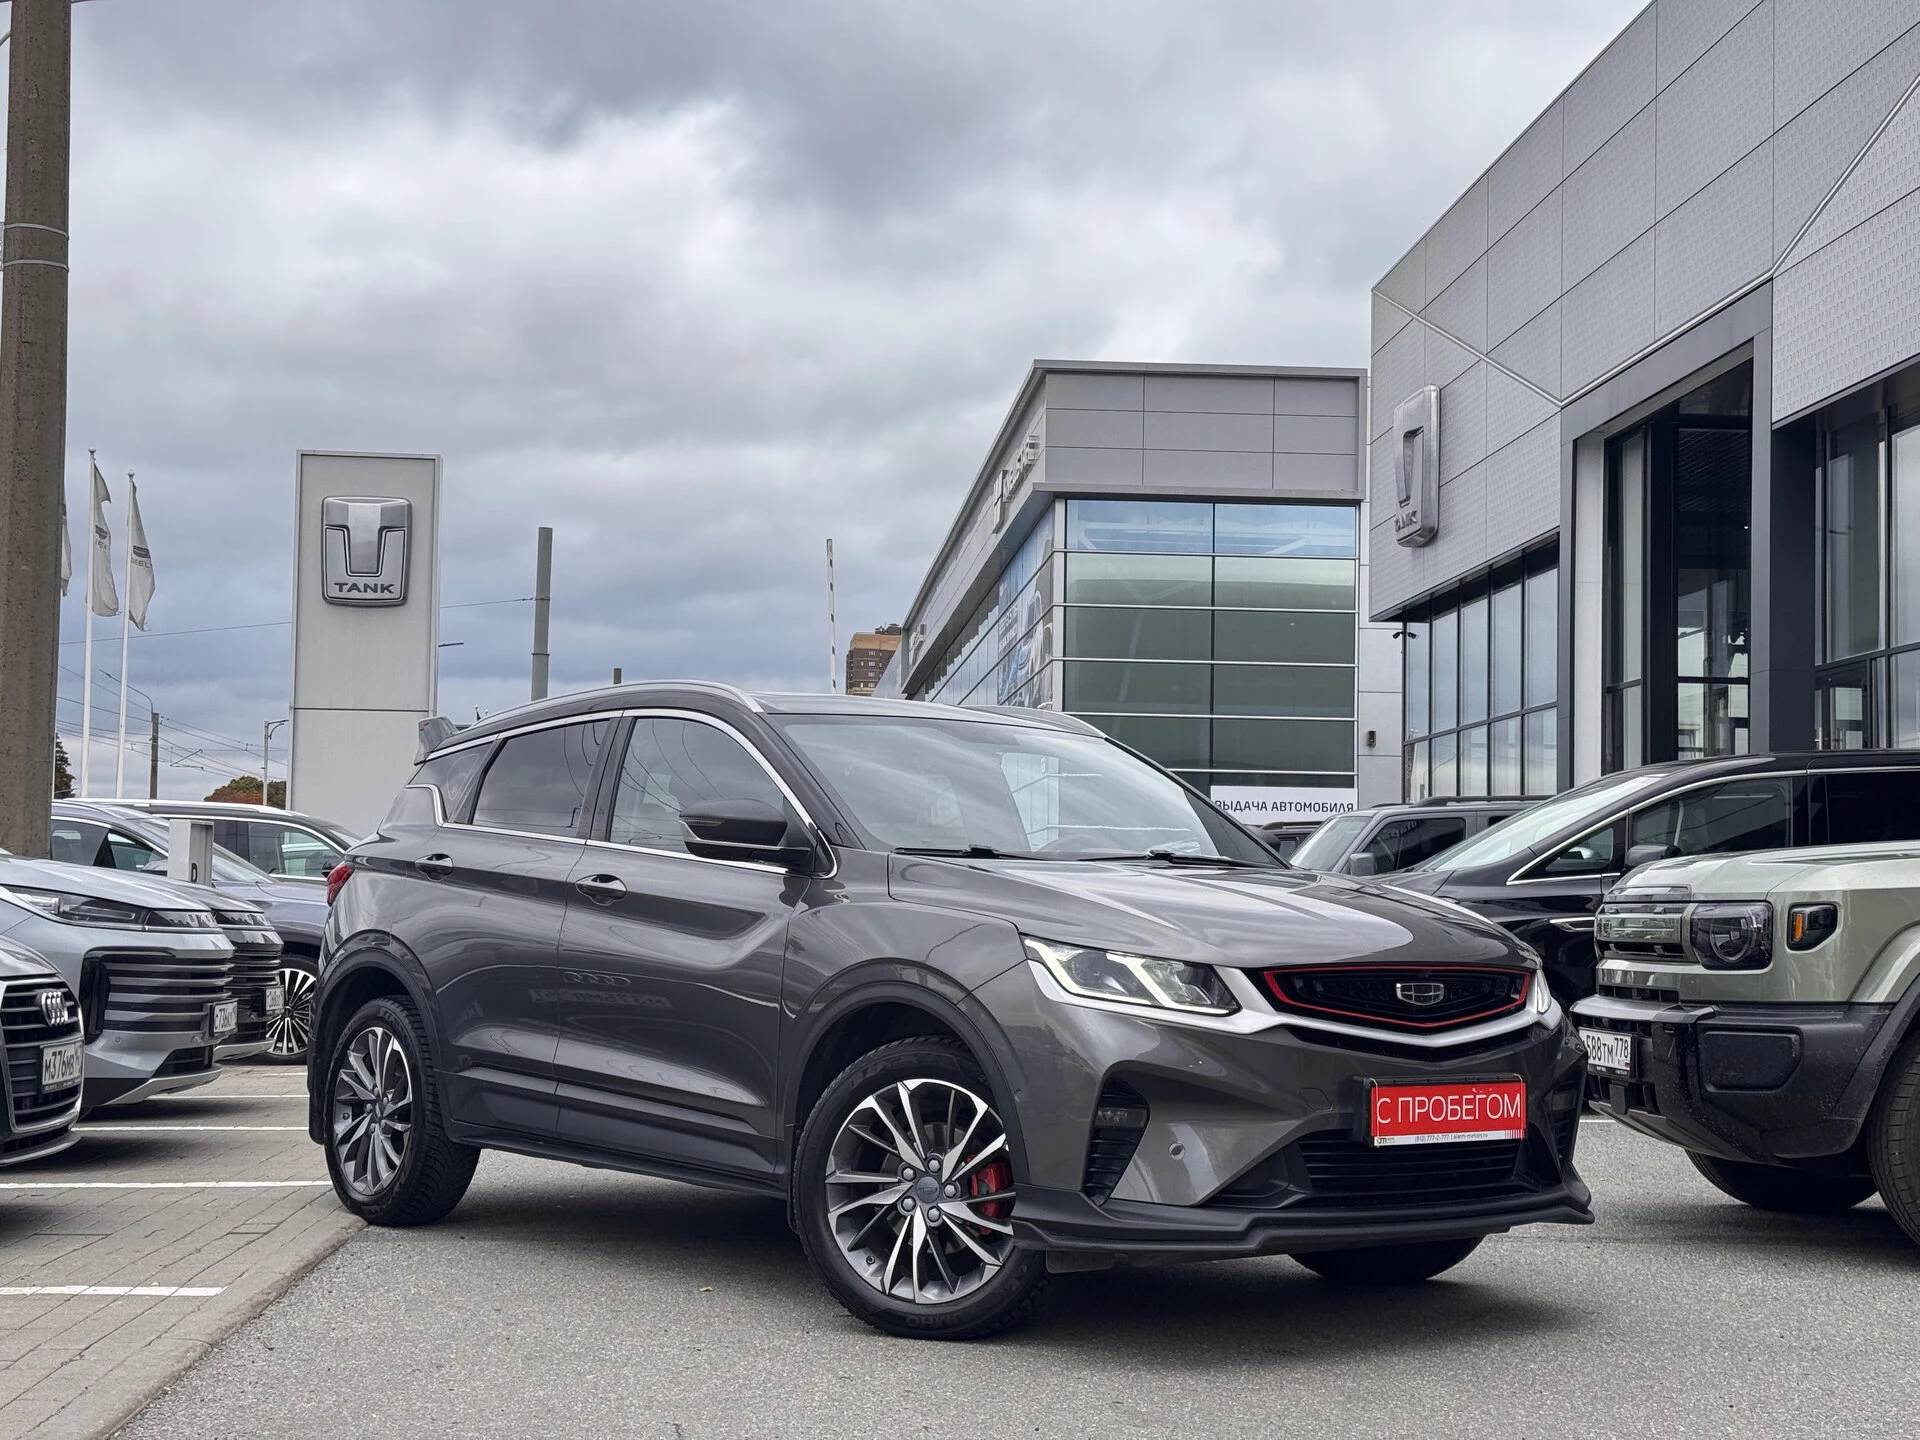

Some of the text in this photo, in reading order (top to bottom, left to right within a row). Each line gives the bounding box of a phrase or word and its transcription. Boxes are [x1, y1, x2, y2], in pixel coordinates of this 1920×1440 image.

[333, 582, 395, 594] TANK
[1271, 801, 1354, 813] АВТОМОБИЛЯ
[1584, 1034, 1629, 1065] 588ТМ 778
[1376, 1093, 1521, 1124] С ПРОБЕГОМ
